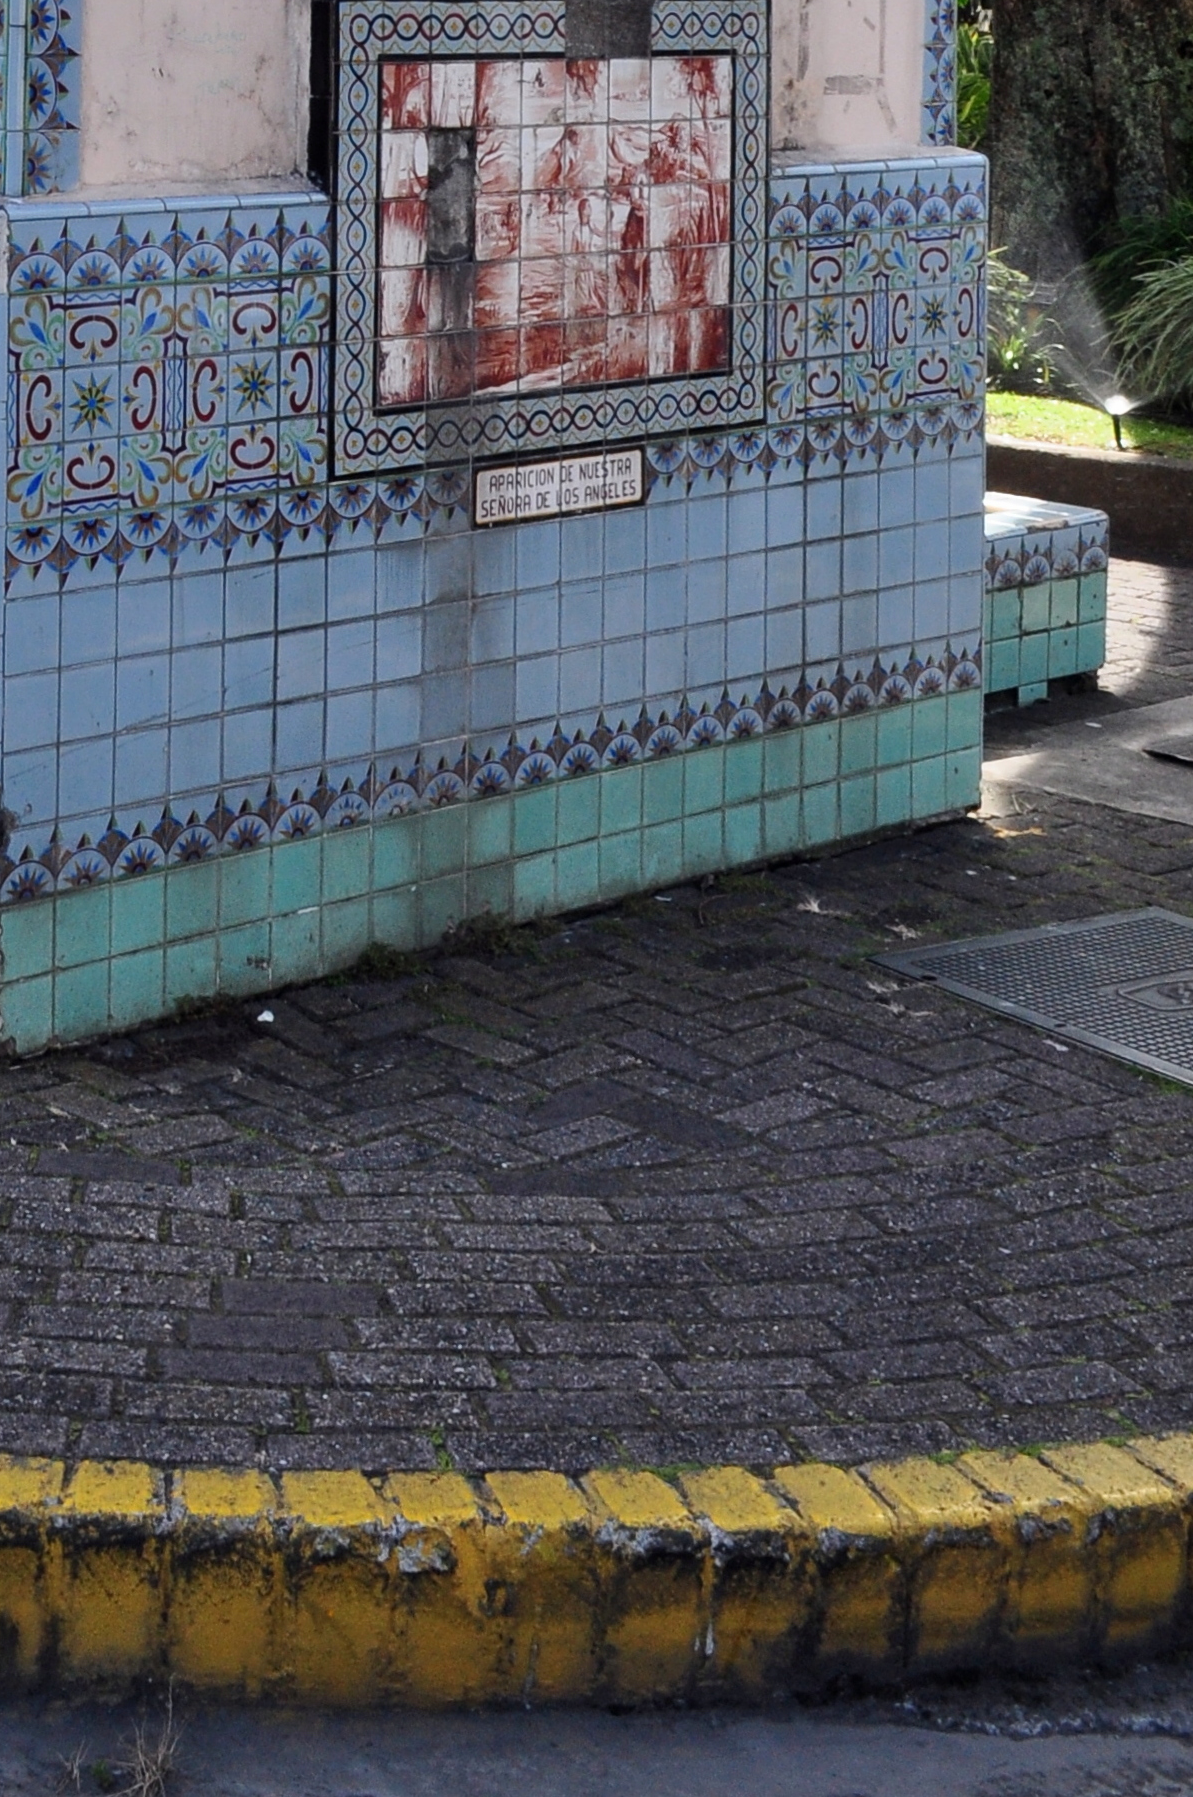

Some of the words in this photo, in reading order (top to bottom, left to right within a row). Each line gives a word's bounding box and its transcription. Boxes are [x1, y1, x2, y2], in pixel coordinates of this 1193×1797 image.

[489, 466, 554, 493] APARICION
[560, 465, 574, 483] DE
[579, 457, 632, 480] NUESTRA
[481, 492, 531, 518] SEÑORA
[536, 491, 551, 509] DE
[557, 488, 580, 506] LOS
[584, 479, 636, 501] ANGELES
